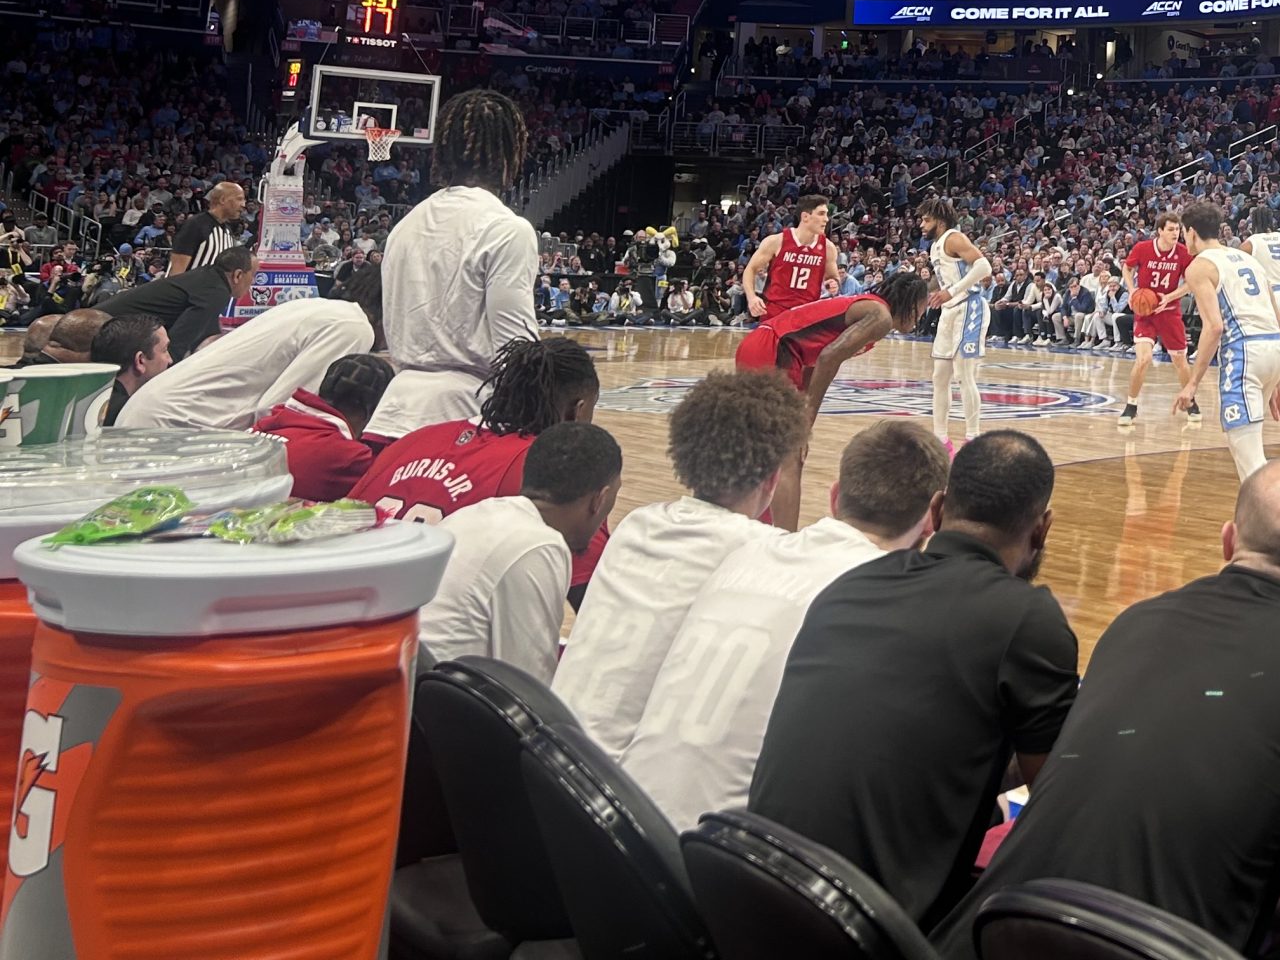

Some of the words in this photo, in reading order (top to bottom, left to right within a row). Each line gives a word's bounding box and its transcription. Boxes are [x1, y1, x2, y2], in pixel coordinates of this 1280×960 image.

[892, 6, 934, 18] ACCN
[950, 7, 1009, 20] COME
[1012, 6, 1053, 20] FOR
[1055, 6, 1073, 19] IT
[1074, 5, 1110, 19] ALL
[1148, 0, 1183, 12] ACCN
[364, 6, 393, 35] 17
[360, 37, 398, 48] TISSOT
[783, 252, 796, 264] NC
[797, 253, 823, 266] STATE
[1147, 260, 1157, 270] NC
[1158, 261, 1178, 271] STATE
[789, 267, 810, 290] 12
[1150, 271, 1171, 289] 34
[1238, 268, 1260, 296] 3
[390, 458, 455, 487] BURNS
[447, 476, 473, 502] JR.
